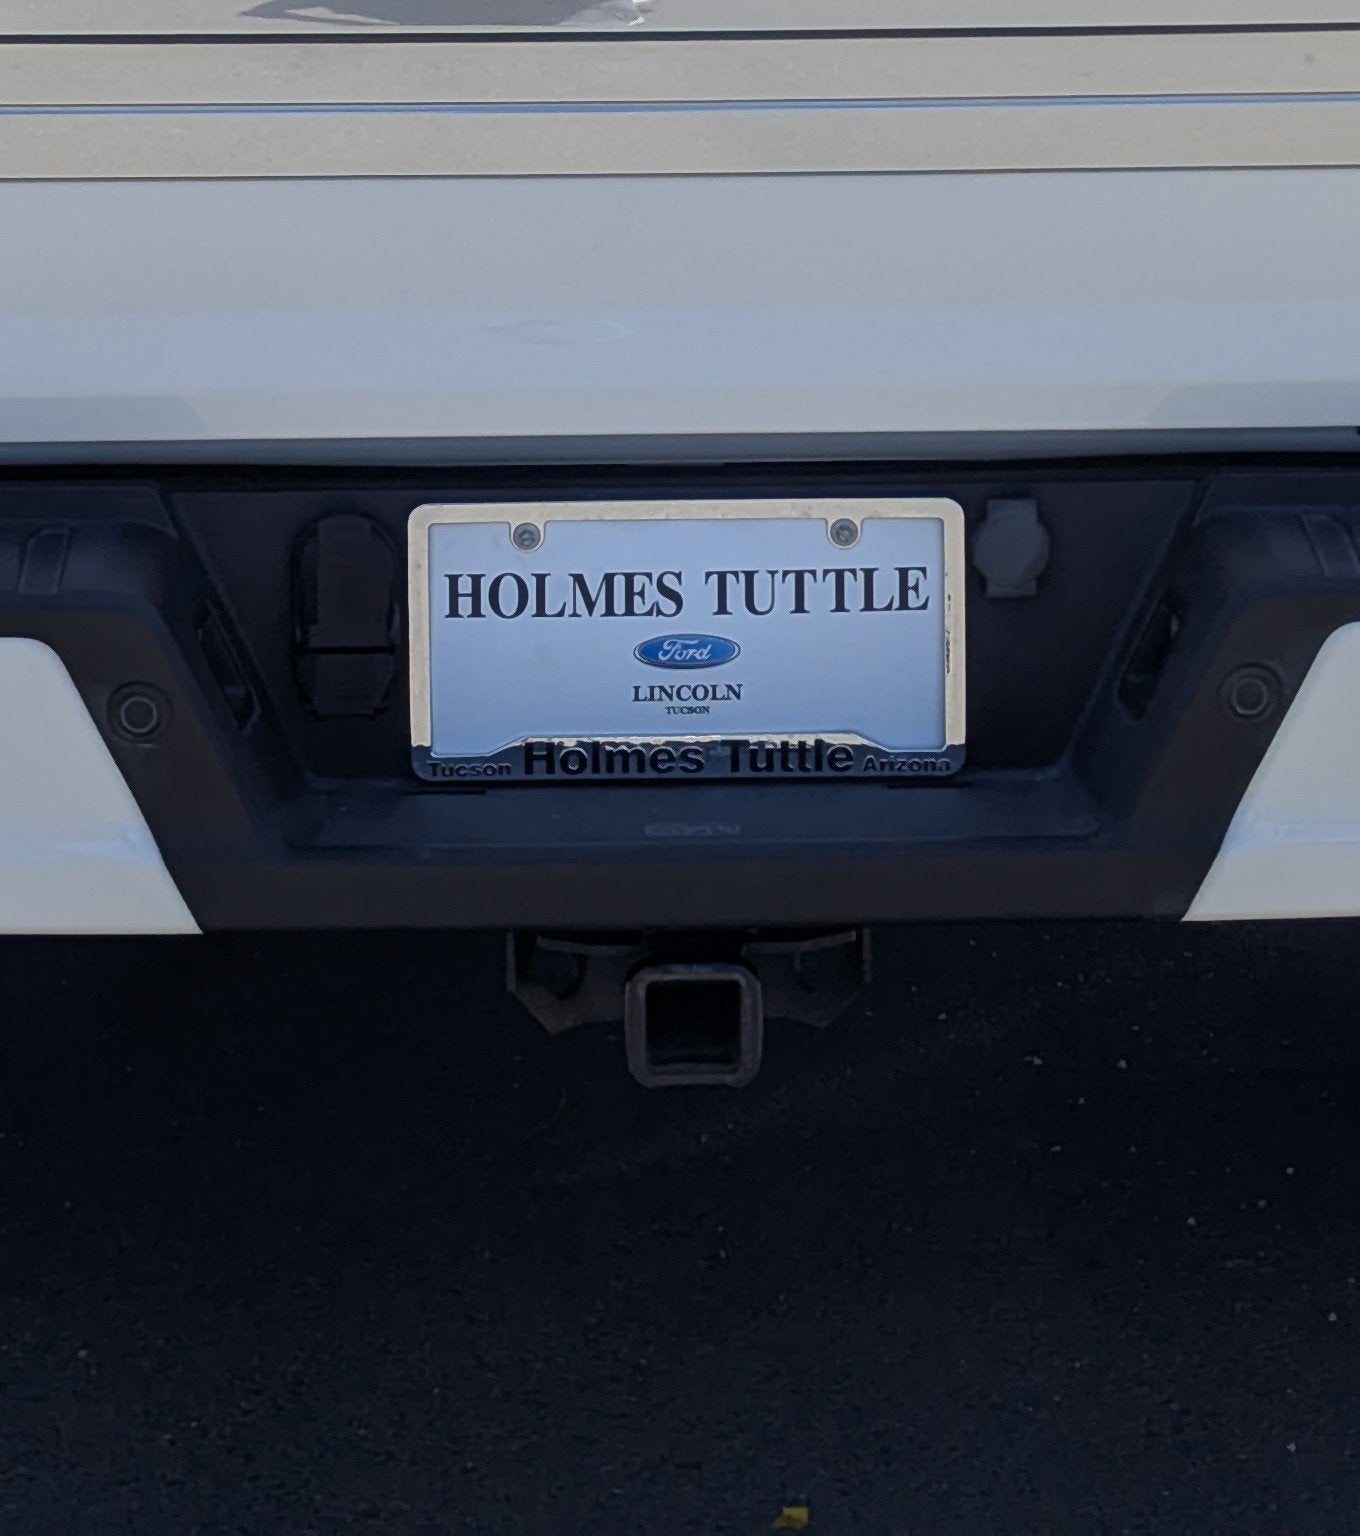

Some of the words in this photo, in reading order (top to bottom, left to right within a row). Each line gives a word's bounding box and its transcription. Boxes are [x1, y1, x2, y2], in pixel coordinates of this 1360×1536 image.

[444, 570, 684, 619] HOLMES
[705, 566, 930, 616] TUTTLE
[658, 638, 712, 661] Ford
[632, 684, 743, 702] LINCOLN
[665, 705, 710, 715] TUCSON
[427, 761, 512, 778] Tucson
[524, 741, 705, 776] Holmes
[720, 737, 855, 773] Tuttle
[863, 754, 952, 773] Arizona
